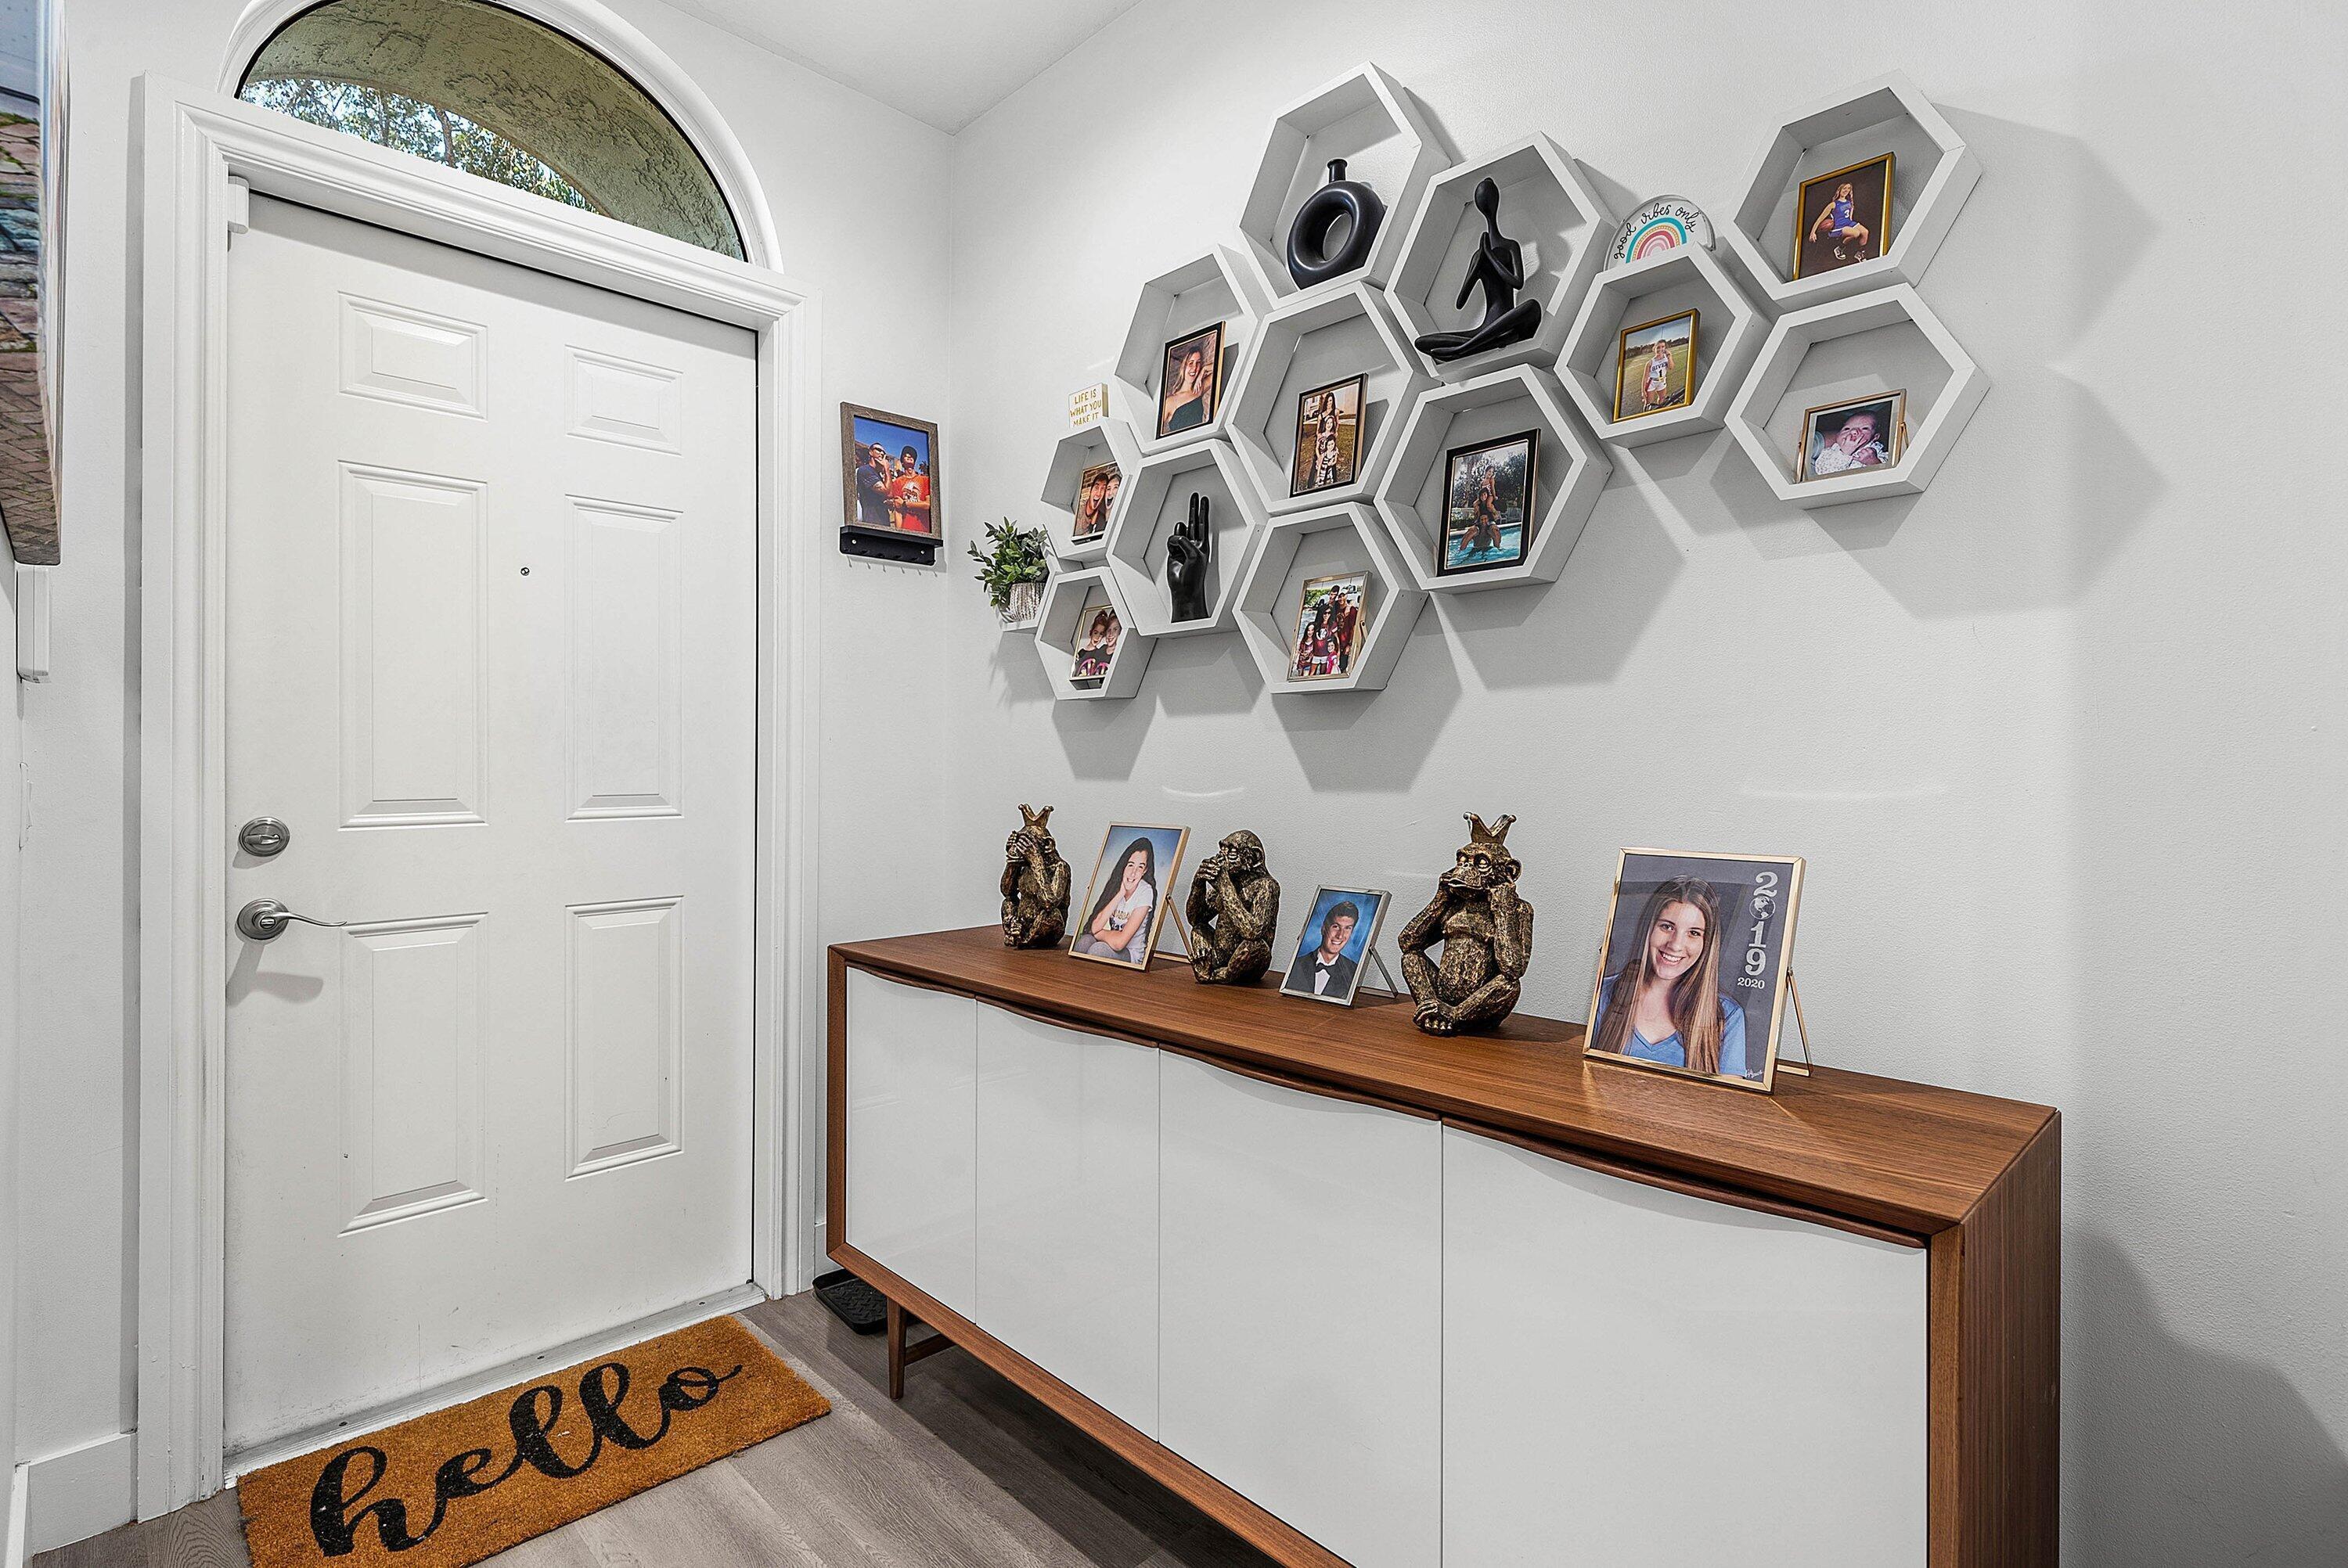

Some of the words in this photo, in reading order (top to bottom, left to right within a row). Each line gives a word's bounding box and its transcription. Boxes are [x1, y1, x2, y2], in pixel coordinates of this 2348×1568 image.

[1844, 209, 1849, 218] 3
[1614, 222, 1637, 259] good
[1641, 203, 1672, 225] vibes
[1675, 207, 1699, 233] only
[1075, 391, 1089, 405] LIFE
[1090, 388, 1097, 398] IS
[1070, 405, 1088, 417] WHAT
[1089, 400, 1102, 410] YOU
[1073, 414, 1090, 426] MAKE
[1092, 412, 1099, 420] IT
[1737, 977, 1765, 990] 2020
[310, 1361, 743, 1556] hello
